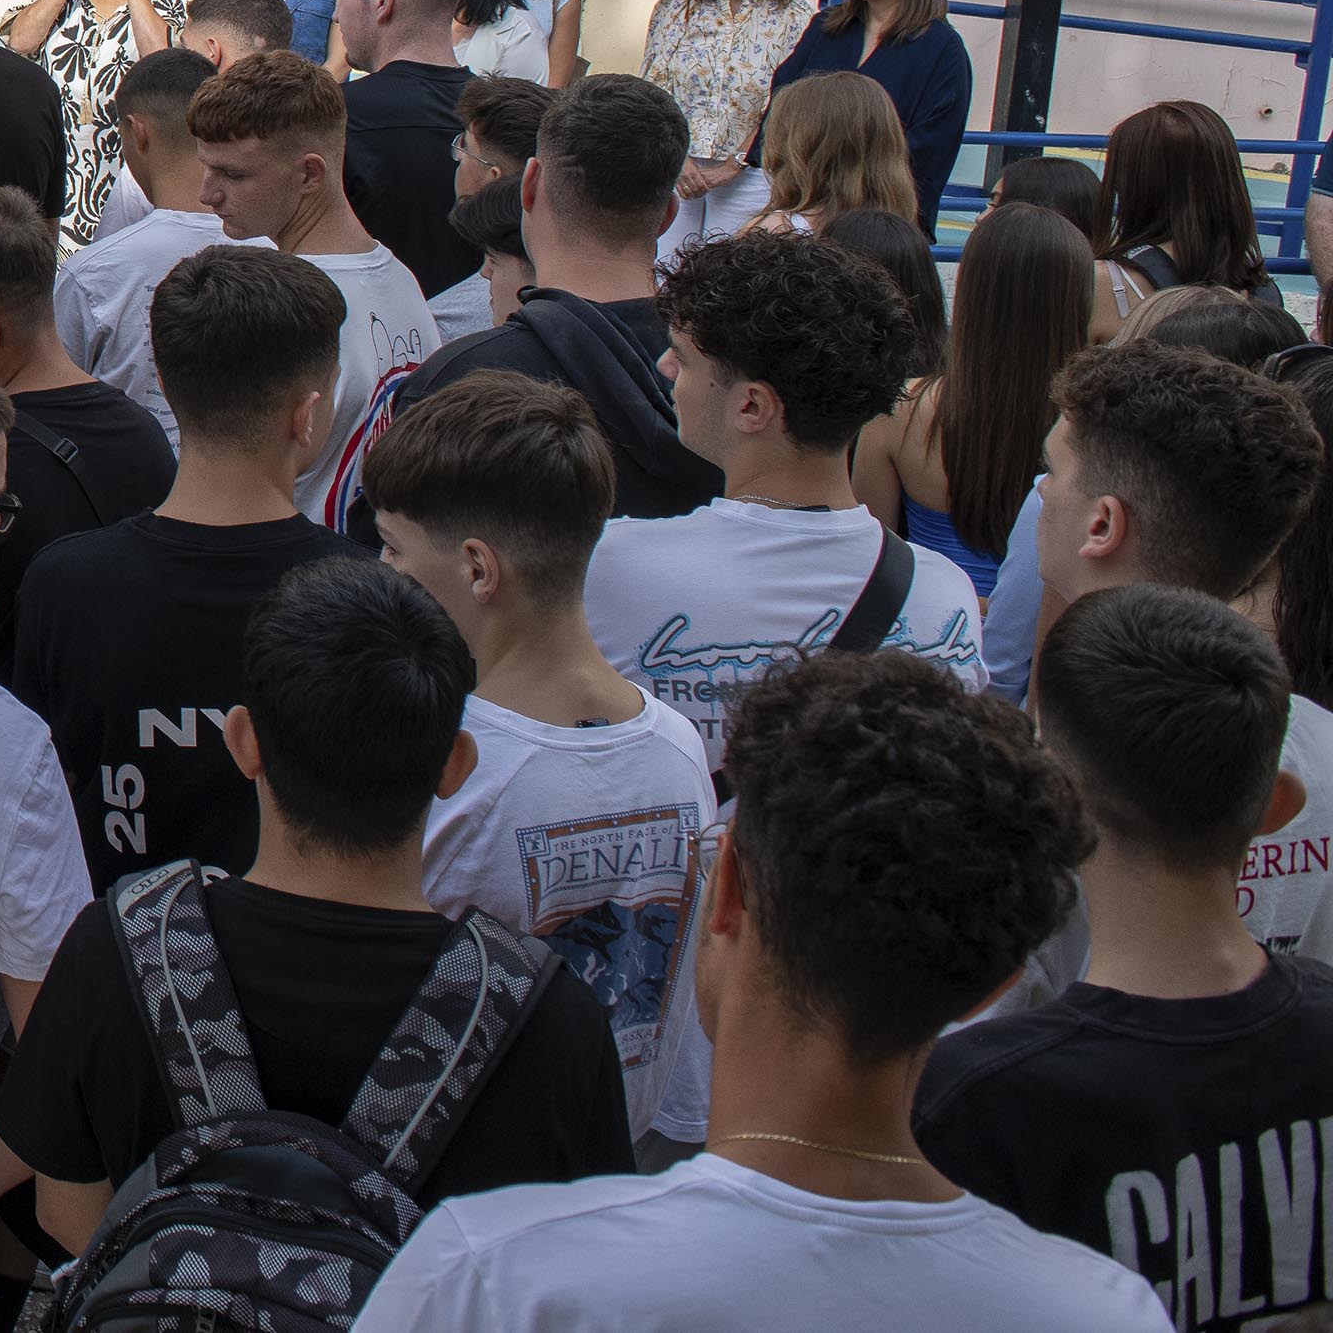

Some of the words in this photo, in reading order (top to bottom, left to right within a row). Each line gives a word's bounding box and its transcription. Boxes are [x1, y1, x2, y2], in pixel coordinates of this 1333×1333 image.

[101, 763, 147, 854] 25
[542, 837, 685, 891] DENALI
[553, 840, 577, 853] THE
[581, 832, 624, 847] NORTH
[628, 826, 657, 840] FACE
